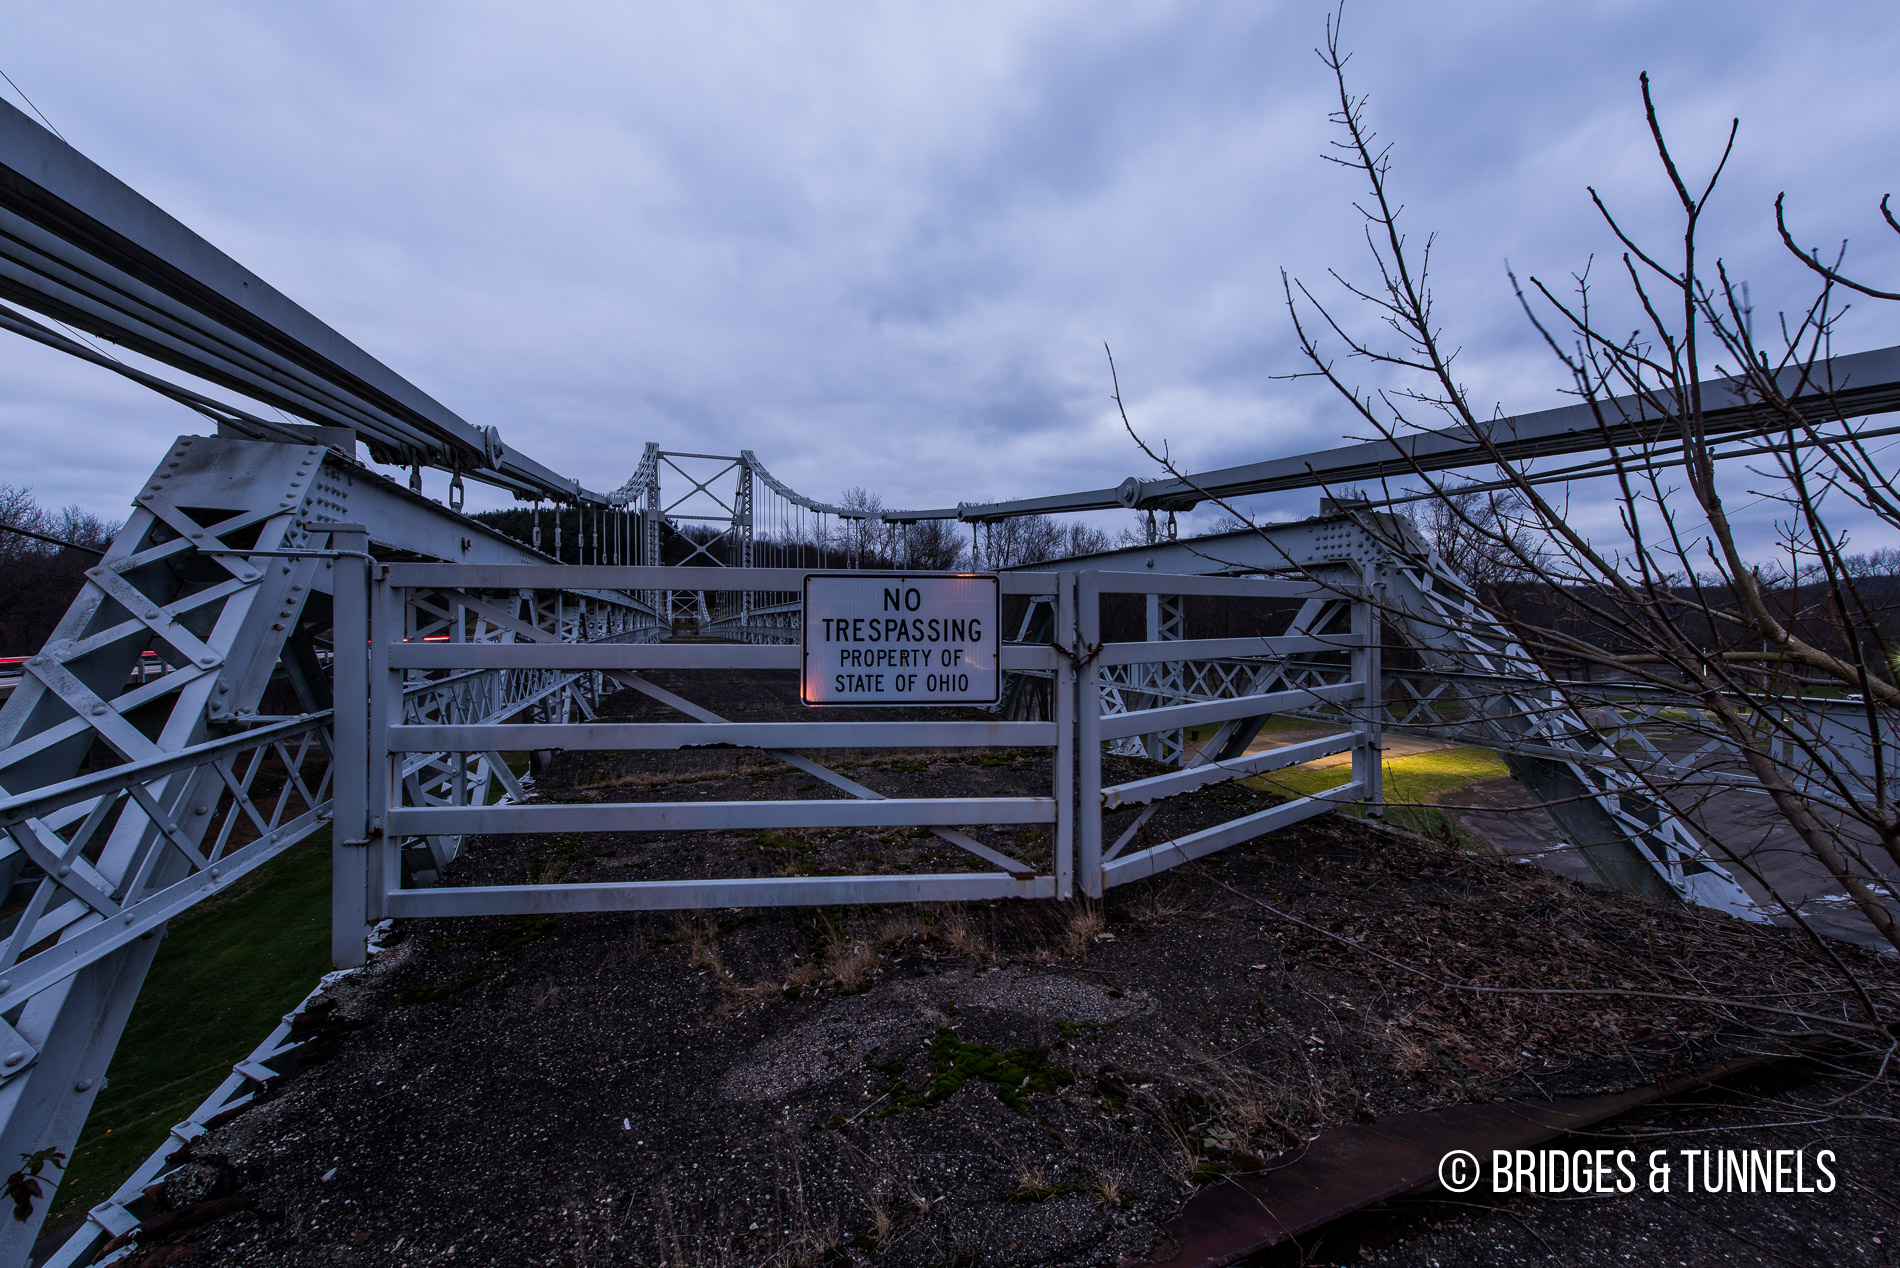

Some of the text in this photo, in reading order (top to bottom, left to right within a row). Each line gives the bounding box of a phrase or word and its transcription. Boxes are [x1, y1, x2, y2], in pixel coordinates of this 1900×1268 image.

[884, 588, 921, 611] NO
[822, 618, 982, 642] TRESPASSING
[840, 649, 963, 667] PROPERTY OF
[835, 674, 968, 692] STATE OF OHIO
